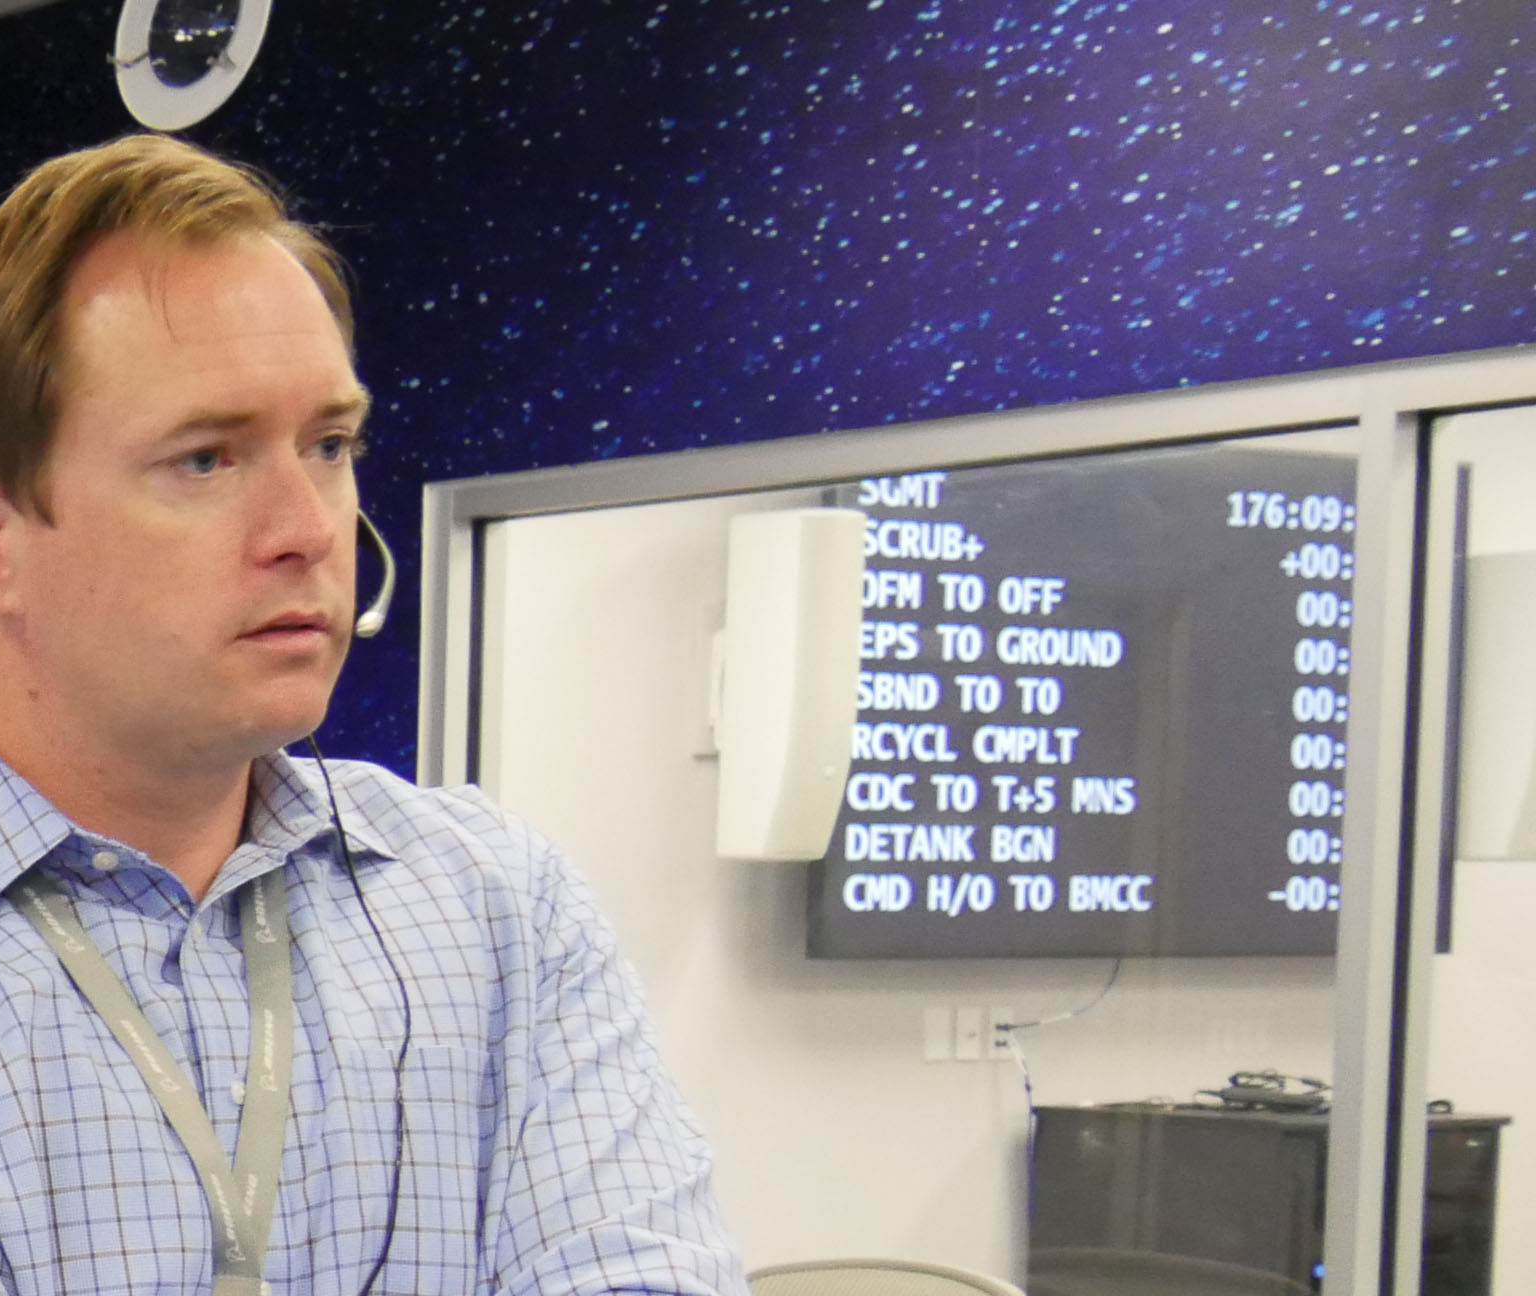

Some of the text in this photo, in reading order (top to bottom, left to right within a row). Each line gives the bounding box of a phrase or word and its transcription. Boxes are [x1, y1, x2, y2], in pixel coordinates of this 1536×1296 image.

[857, 473, 946, 509] SGMT
[863, 520, 984, 561] SCRUB+
[937, 574, 984, 613] TO
[997, 577, 1064, 615] OFF
[858, 622, 1122, 668] EPS TO GROUND
[855, 673, 939, 711] SBND
[954, 676, 1001, 714] TO
[850, 724, 1079, 764] RCYCL CMPLT
[846, 774, 1135, 815] CDC TO T+5 MNS
[844, 824, 1055, 862] DETANK BGN
[842, 874, 911, 912] CMD
[1008, 875, 1054, 912] TO
[1068, 875, 1152, 912] BMCC
